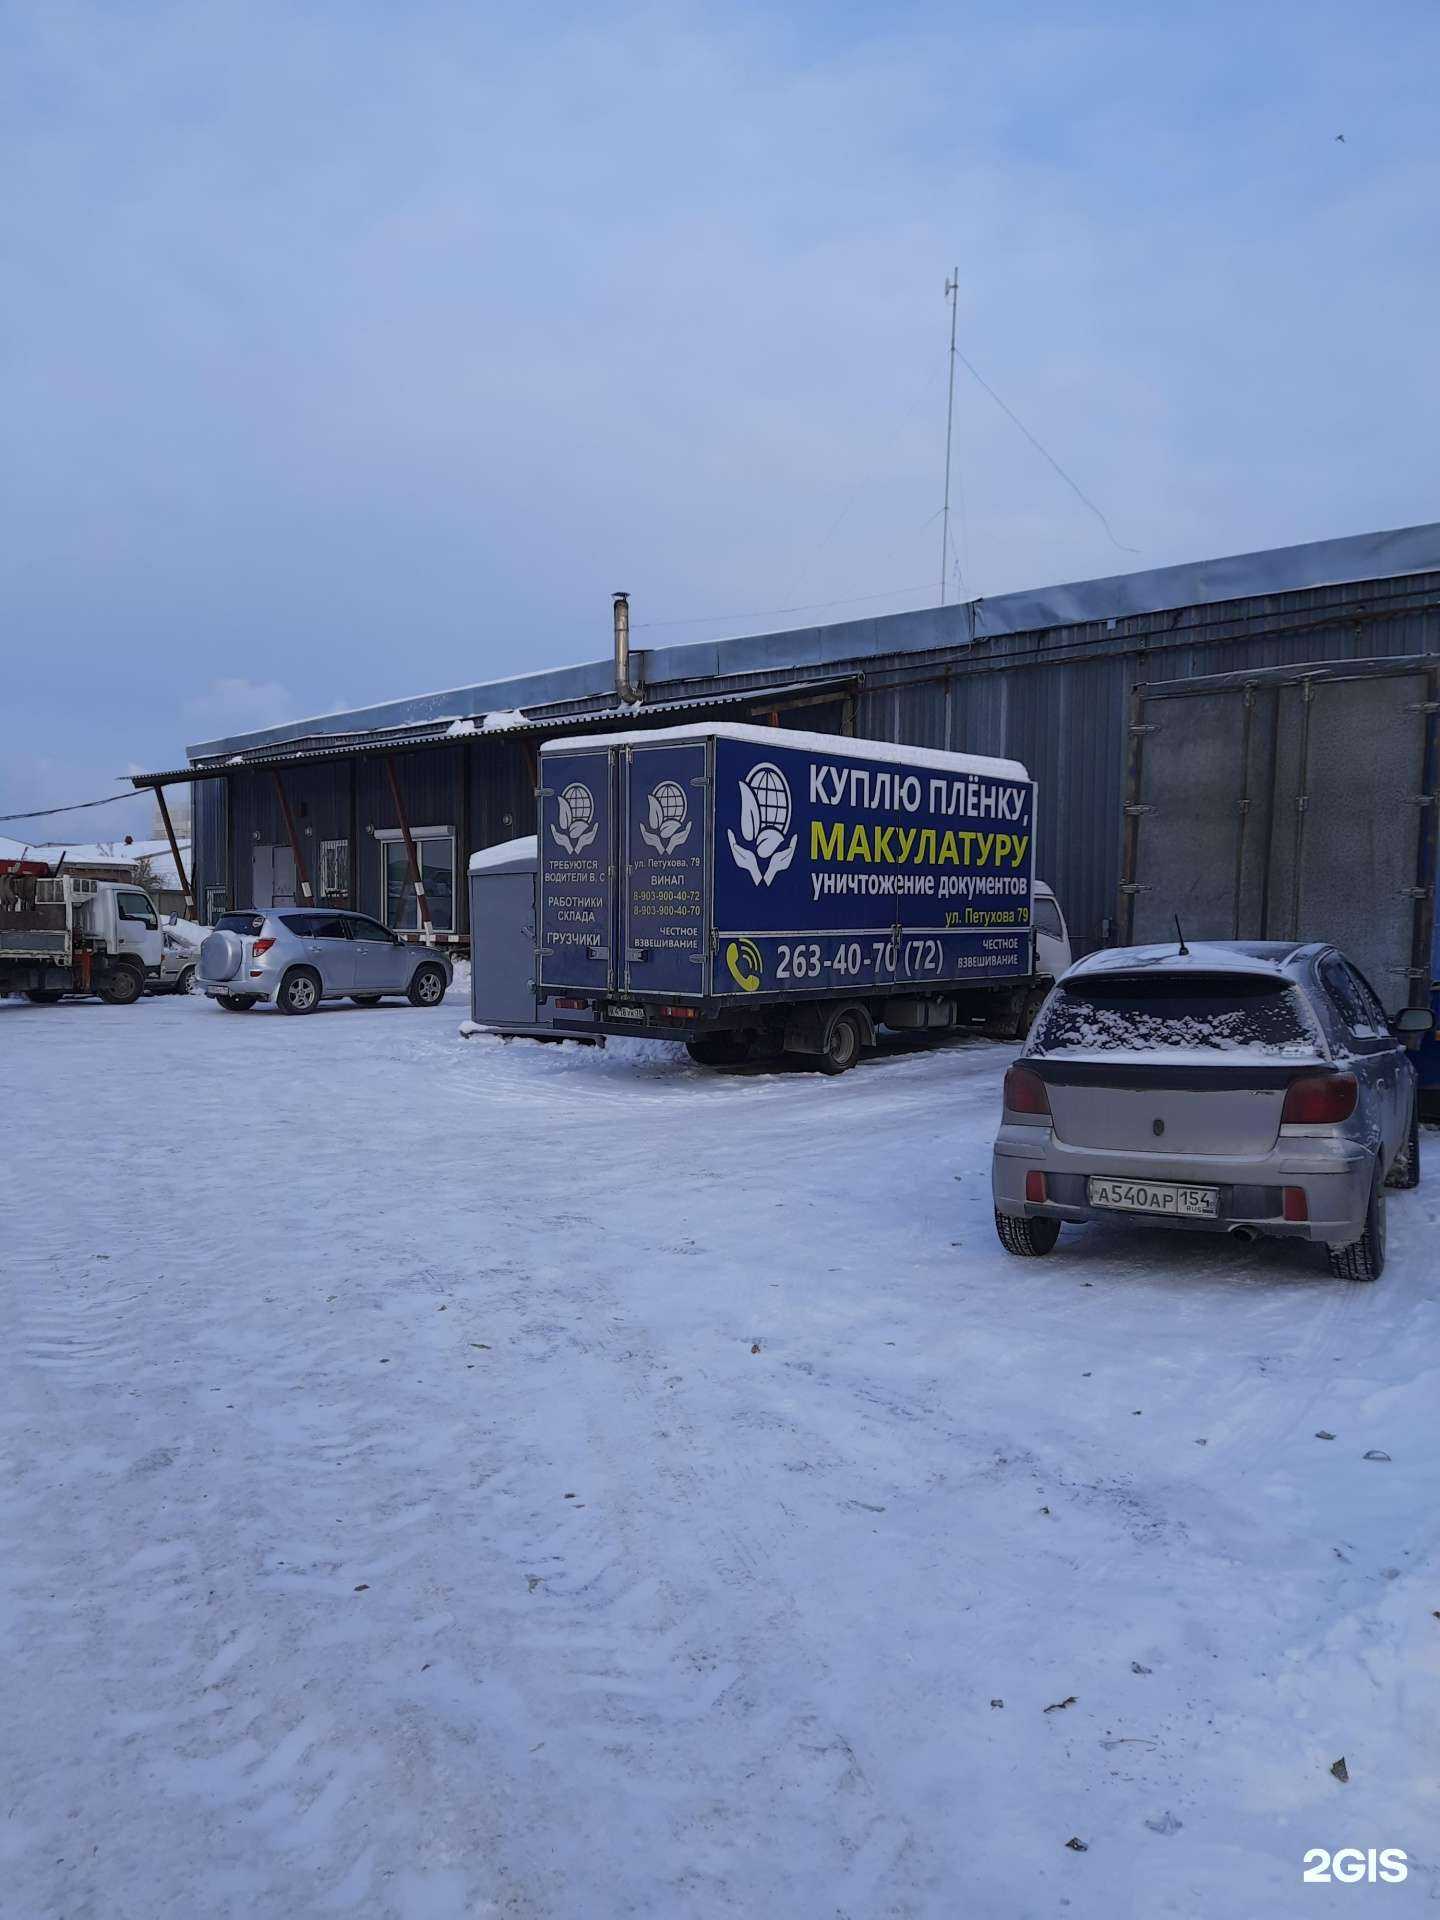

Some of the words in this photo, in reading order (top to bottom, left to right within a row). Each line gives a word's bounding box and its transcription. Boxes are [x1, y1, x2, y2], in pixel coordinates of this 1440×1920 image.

[808, 764, 922, 813] КУПЛЮ
[929, 775, 1029, 826] ПЛЁНКУ,
[810, 820, 1029, 868] МАКУЛАТУРУ
[550, 860, 598, 870] ТРЕБУЮТСЯ
[690, 857, 700, 867] 79
[544, 872, 587, 883] ВОДИТЕЛИ
[650, 875, 684, 886] ВИНАП
[811, 872, 935, 901] уничтожение
[938, 874, 1028, 900] документов
[548, 896, 603, 908] РАБОТНИКИ
[633, 891, 700, 901] 8-903-900-40-72
[633, 905, 700, 916] 8-903-900-40-70
[557, 911, 595, 924] СКЛАДА
[945, 911, 962, 929] ул.
[965, 907, 1015, 927] Петухова
[1017, 906, 1029, 923] 79
[659, 927, 698, 936] ЧЕСТНОЕ
[547, 932, 601, 947] ГРУЗЧИКИ
[634, 938, 698, 949] ВЗВЕШИВАНИЕ
[982, 938, 1019, 950] ЧЕСТНОЕ
[775, 942, 898, 979] 263-40-70
[903, 939, 944, 976] (72)
[957, 954, 1019, 969] ВЗВЕШИВАНИЕ
[1179, 1191, 1210, 1208] 154
